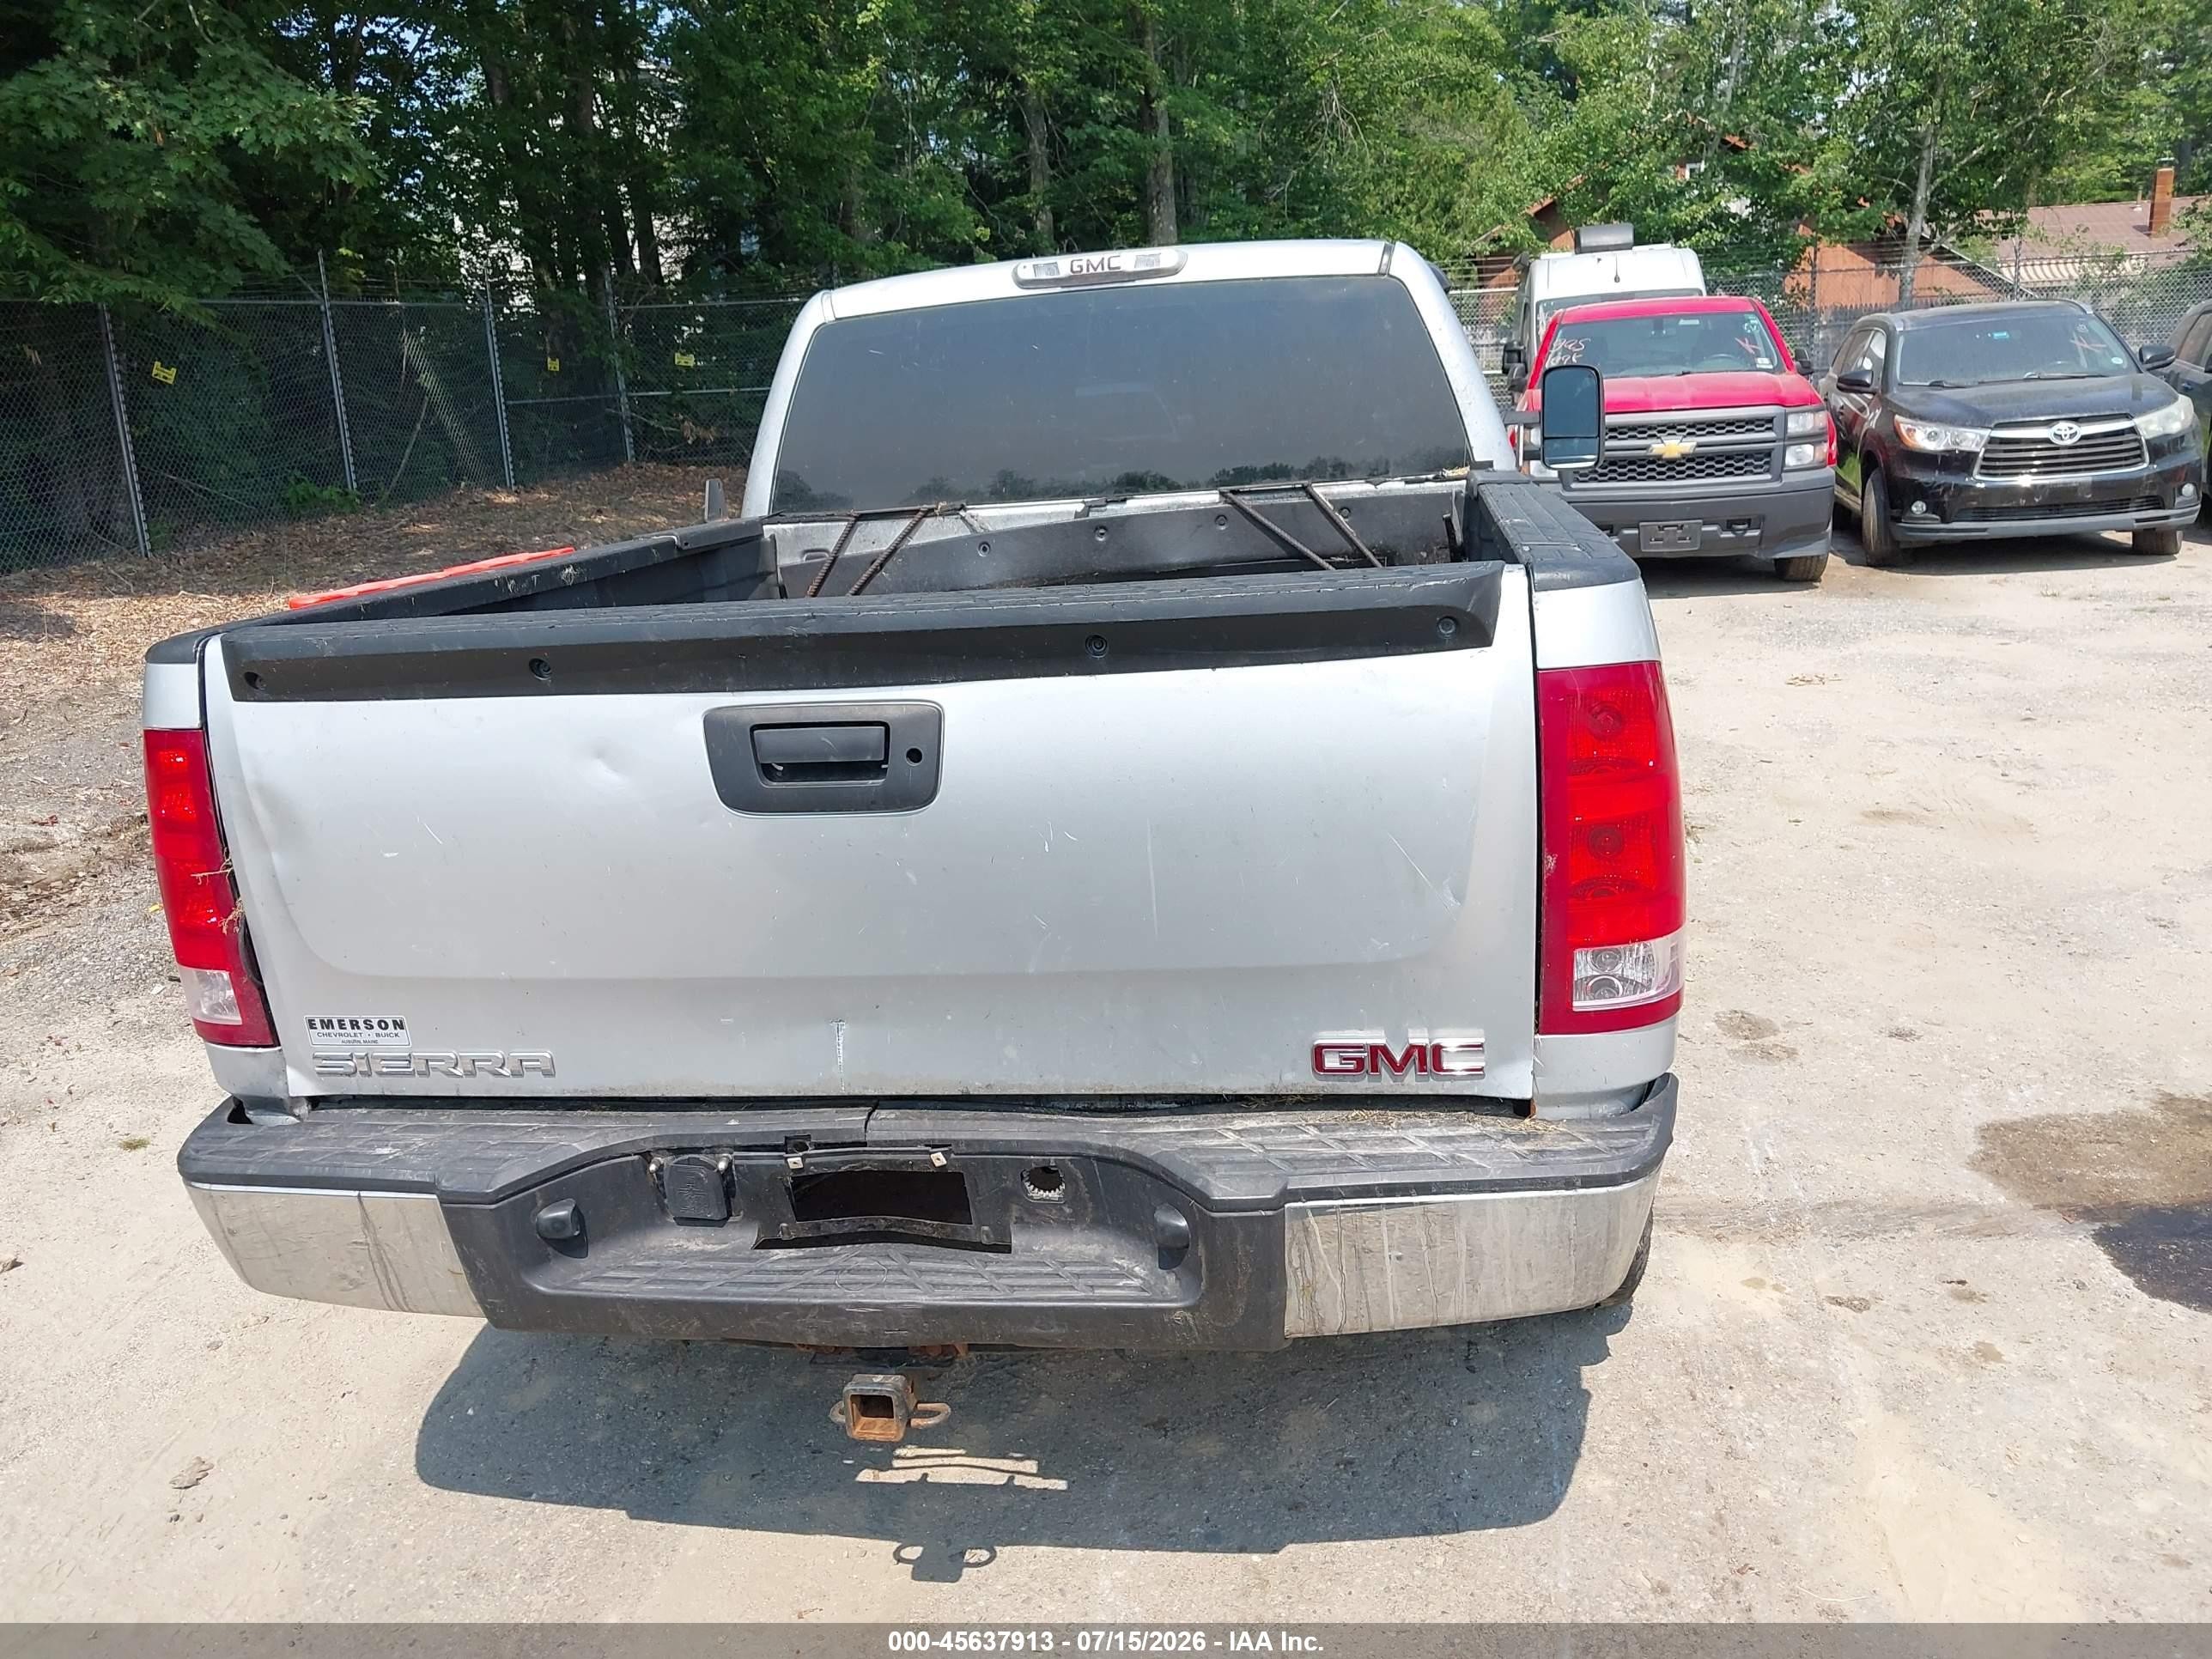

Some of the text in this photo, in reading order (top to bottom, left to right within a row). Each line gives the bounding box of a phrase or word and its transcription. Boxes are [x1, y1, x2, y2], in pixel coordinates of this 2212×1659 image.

[1069, 255, 1121, 275] GMC
[307, 1018, 405, 1030] EMERSON
[312, 1051, 556, 1079] SIERRA
[1311, 1036, 1486, 1080] GMC
